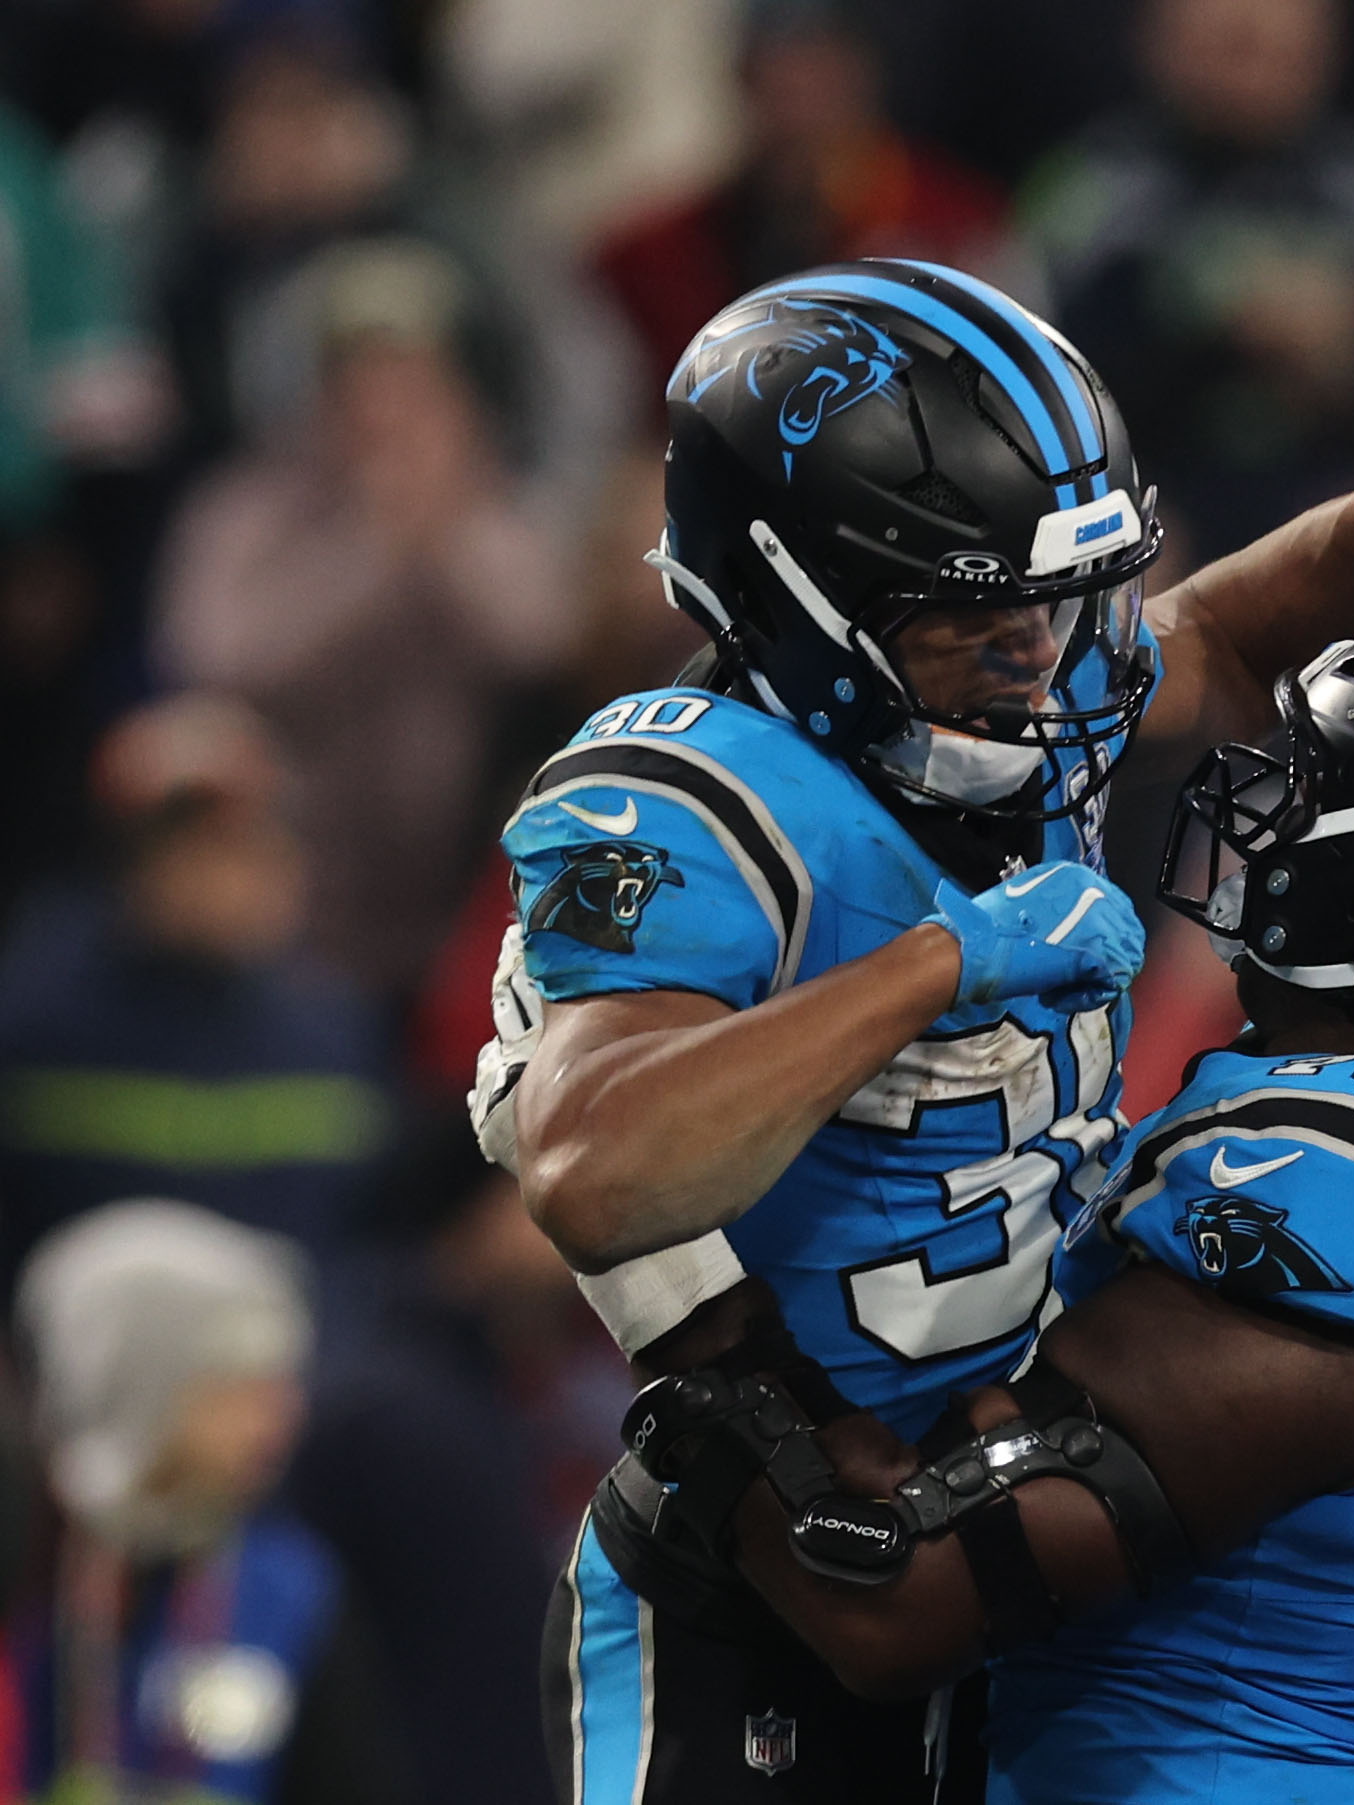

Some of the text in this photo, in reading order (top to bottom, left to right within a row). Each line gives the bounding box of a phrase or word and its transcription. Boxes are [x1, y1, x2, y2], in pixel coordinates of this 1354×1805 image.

[940, 568, 1009, 584] OAKLEY
[587, 696, 713, 738] 30
[812, 1516, 890, 1540] DONJOY
[755, 1738, 789, 1763] NFL
